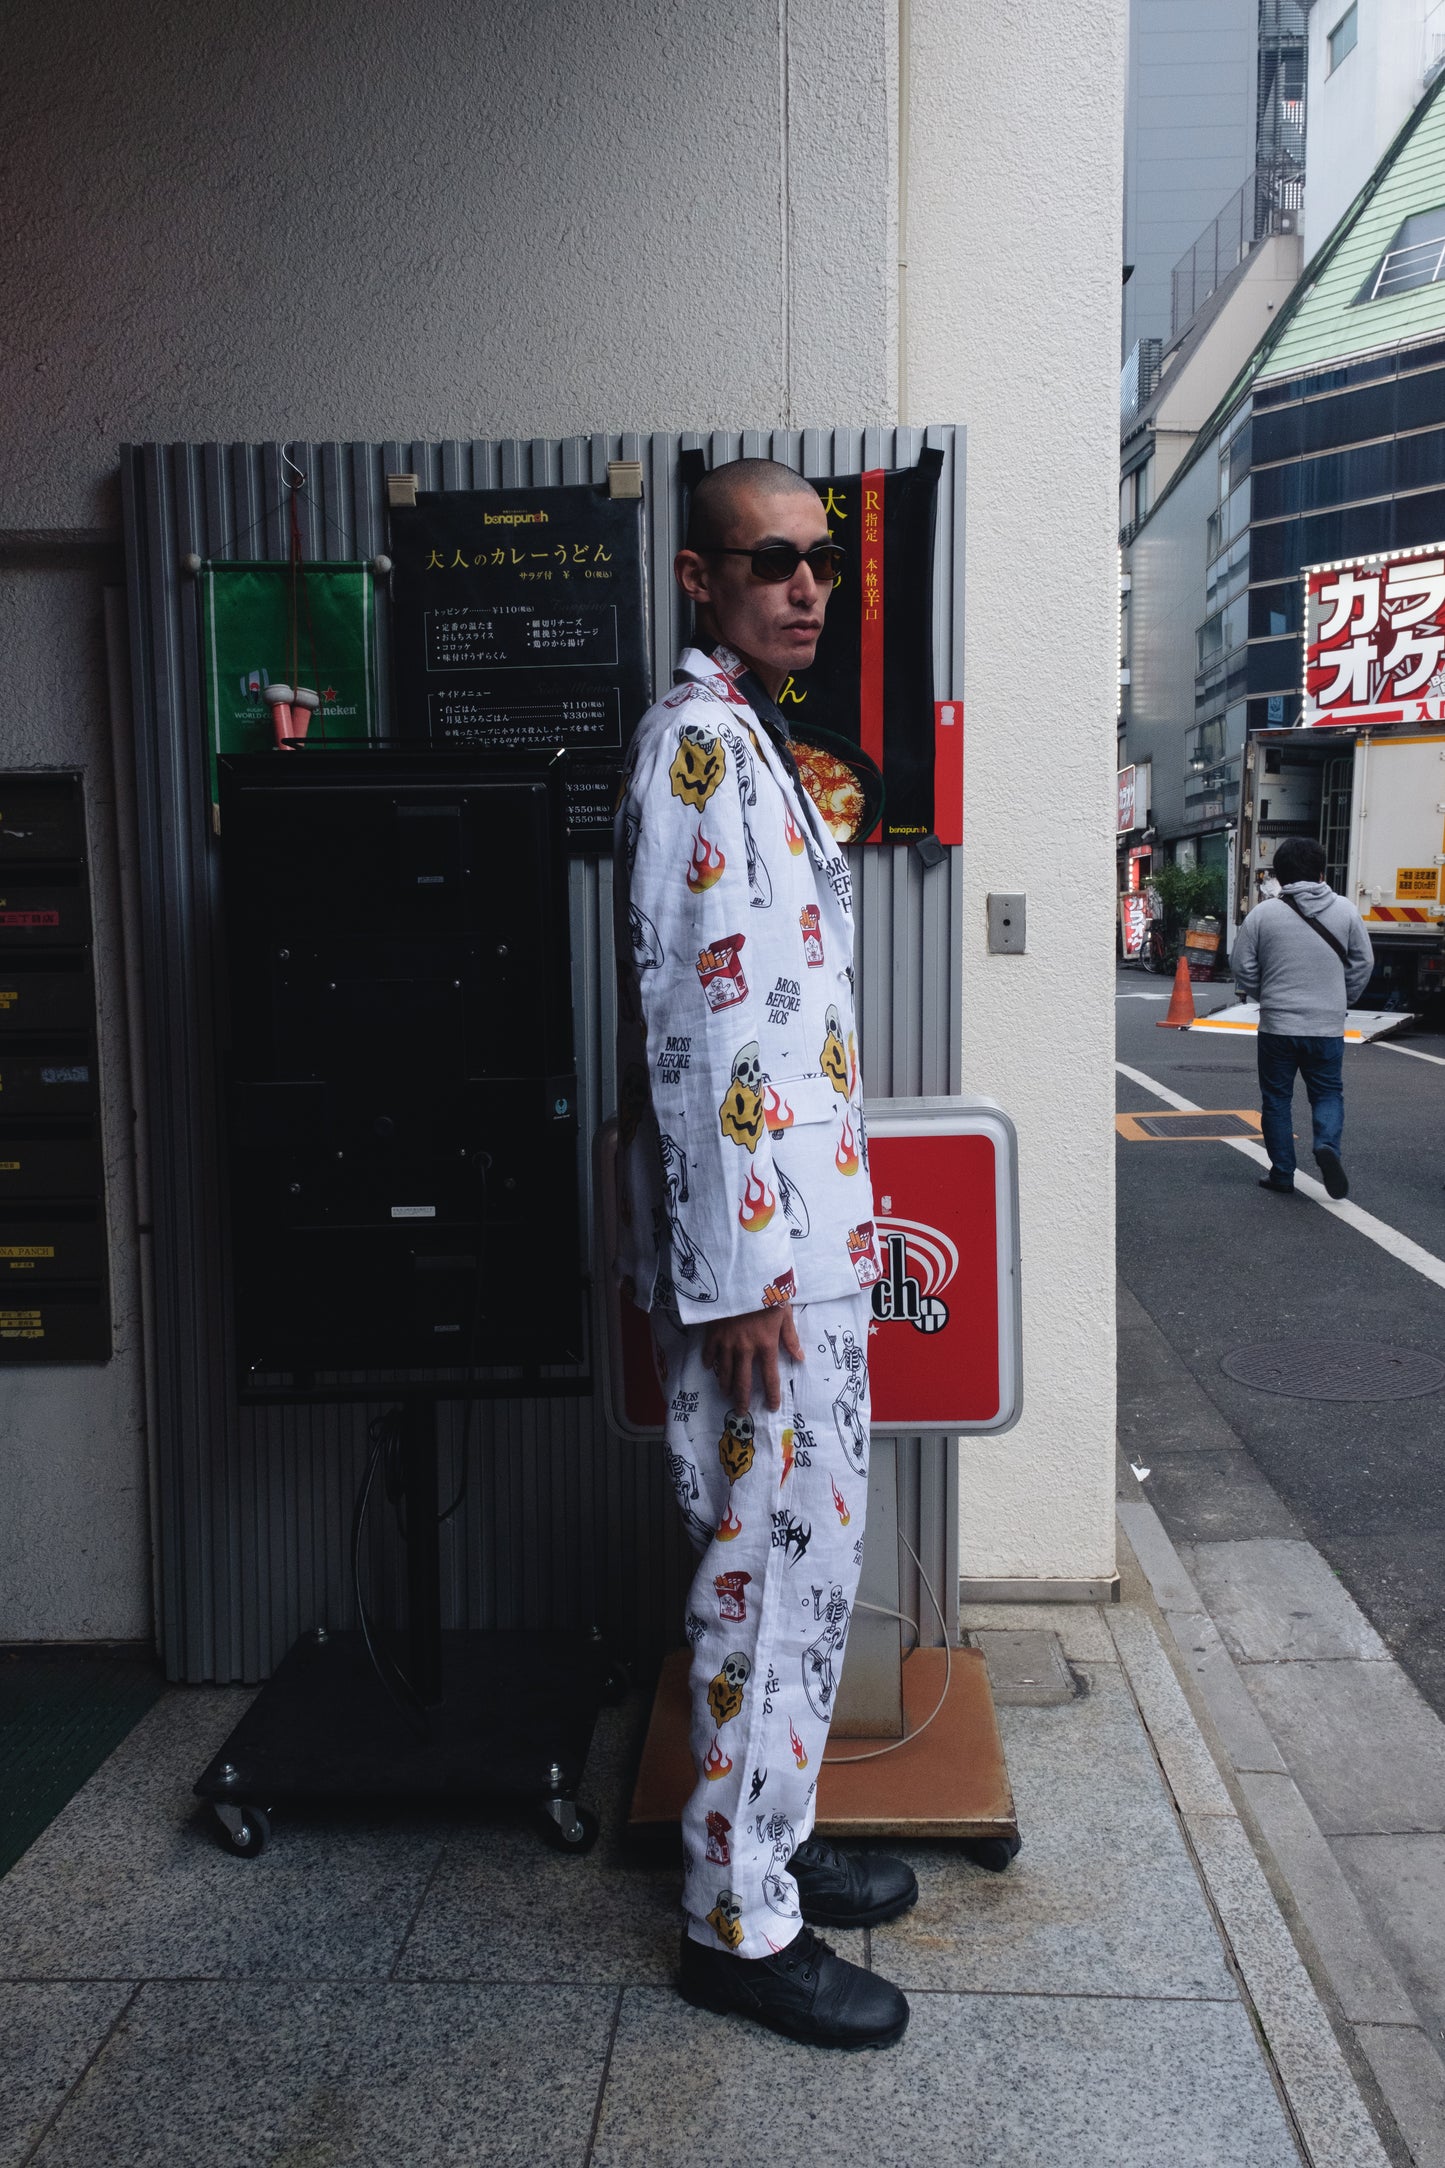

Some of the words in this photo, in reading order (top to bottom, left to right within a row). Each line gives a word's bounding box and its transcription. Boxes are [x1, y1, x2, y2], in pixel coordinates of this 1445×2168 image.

[424, 544, 613, 571] 大人のカレーうどん
[519, 571, 553, 581] サラダ付
[863, 557, 881, 621] 本格辛口
[433, 607, 469, 617] トッピング
[442, 642, 472, 652] コロッケ
[437, 690, 492, 699] サイドメニュー
[445, 705, 478, 714] 白ごはん
[765, 991, 801, 1012] BEFORE
[768, 1009, 789, 1025] HOS
[657, 1052, 691, 1069] BEFORE
[662, 1069, 681, 1084] HOS
[18, 1247, 49, 1256] PANCH
[671, 1400, 699, 1412] BEFORE
[674, 1412, 690, 1423] HOS
